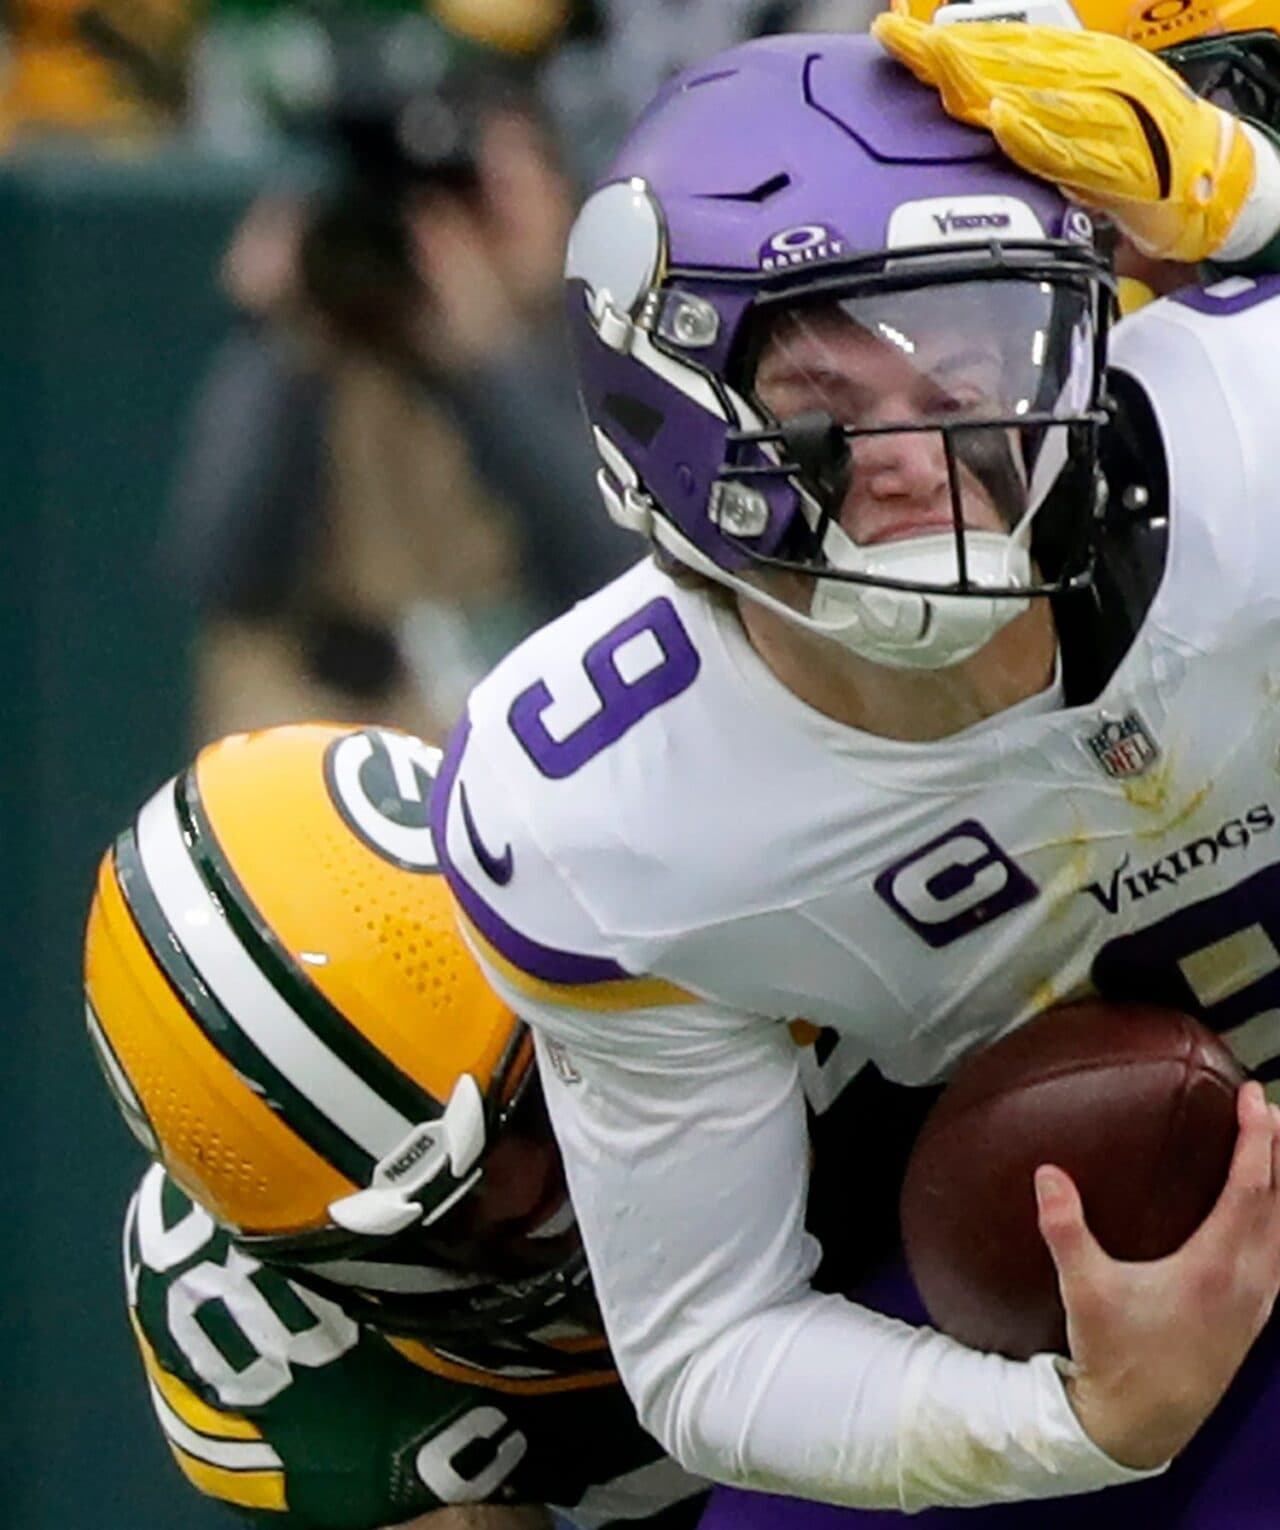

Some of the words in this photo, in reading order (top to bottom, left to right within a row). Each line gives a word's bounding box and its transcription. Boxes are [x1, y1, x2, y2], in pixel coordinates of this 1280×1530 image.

[507, 596, 702, 775] 9
[892, 835, 1008, 925] C
[1079, 803, 1275, 914] VIKINGS
[416, 1405, 527, 1504] C
